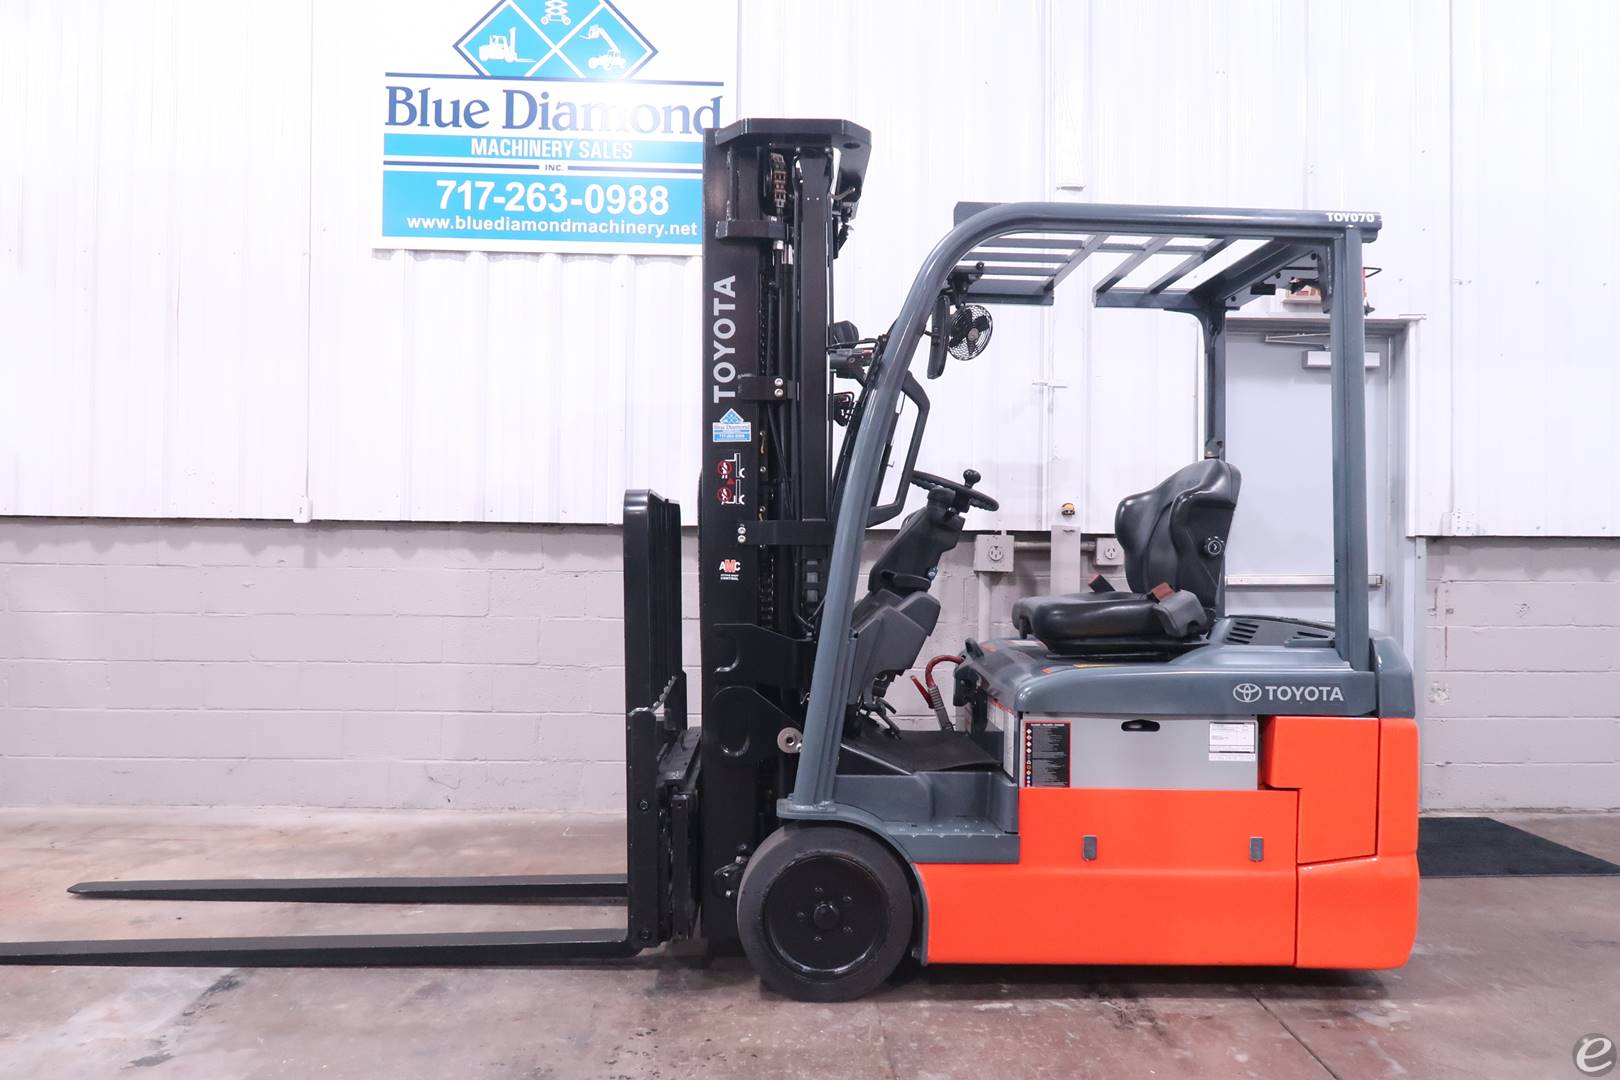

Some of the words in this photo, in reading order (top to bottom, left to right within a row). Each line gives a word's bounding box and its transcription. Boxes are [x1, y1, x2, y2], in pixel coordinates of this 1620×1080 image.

[385, 86, 490, 130] Blue
[502, 89, 724, 135] Diamond
[471, 137, 574, 159] MACHINERY
[578, 140, 633, 160] SALES
[436, 180, 669, 216] 717-263-0988
[406, 215, 698, 238] www.bluediamondmachinery.net
[712, 275, 736, 404] TOYOTA
[1264, 685, 1345, 702] TOYOTA
